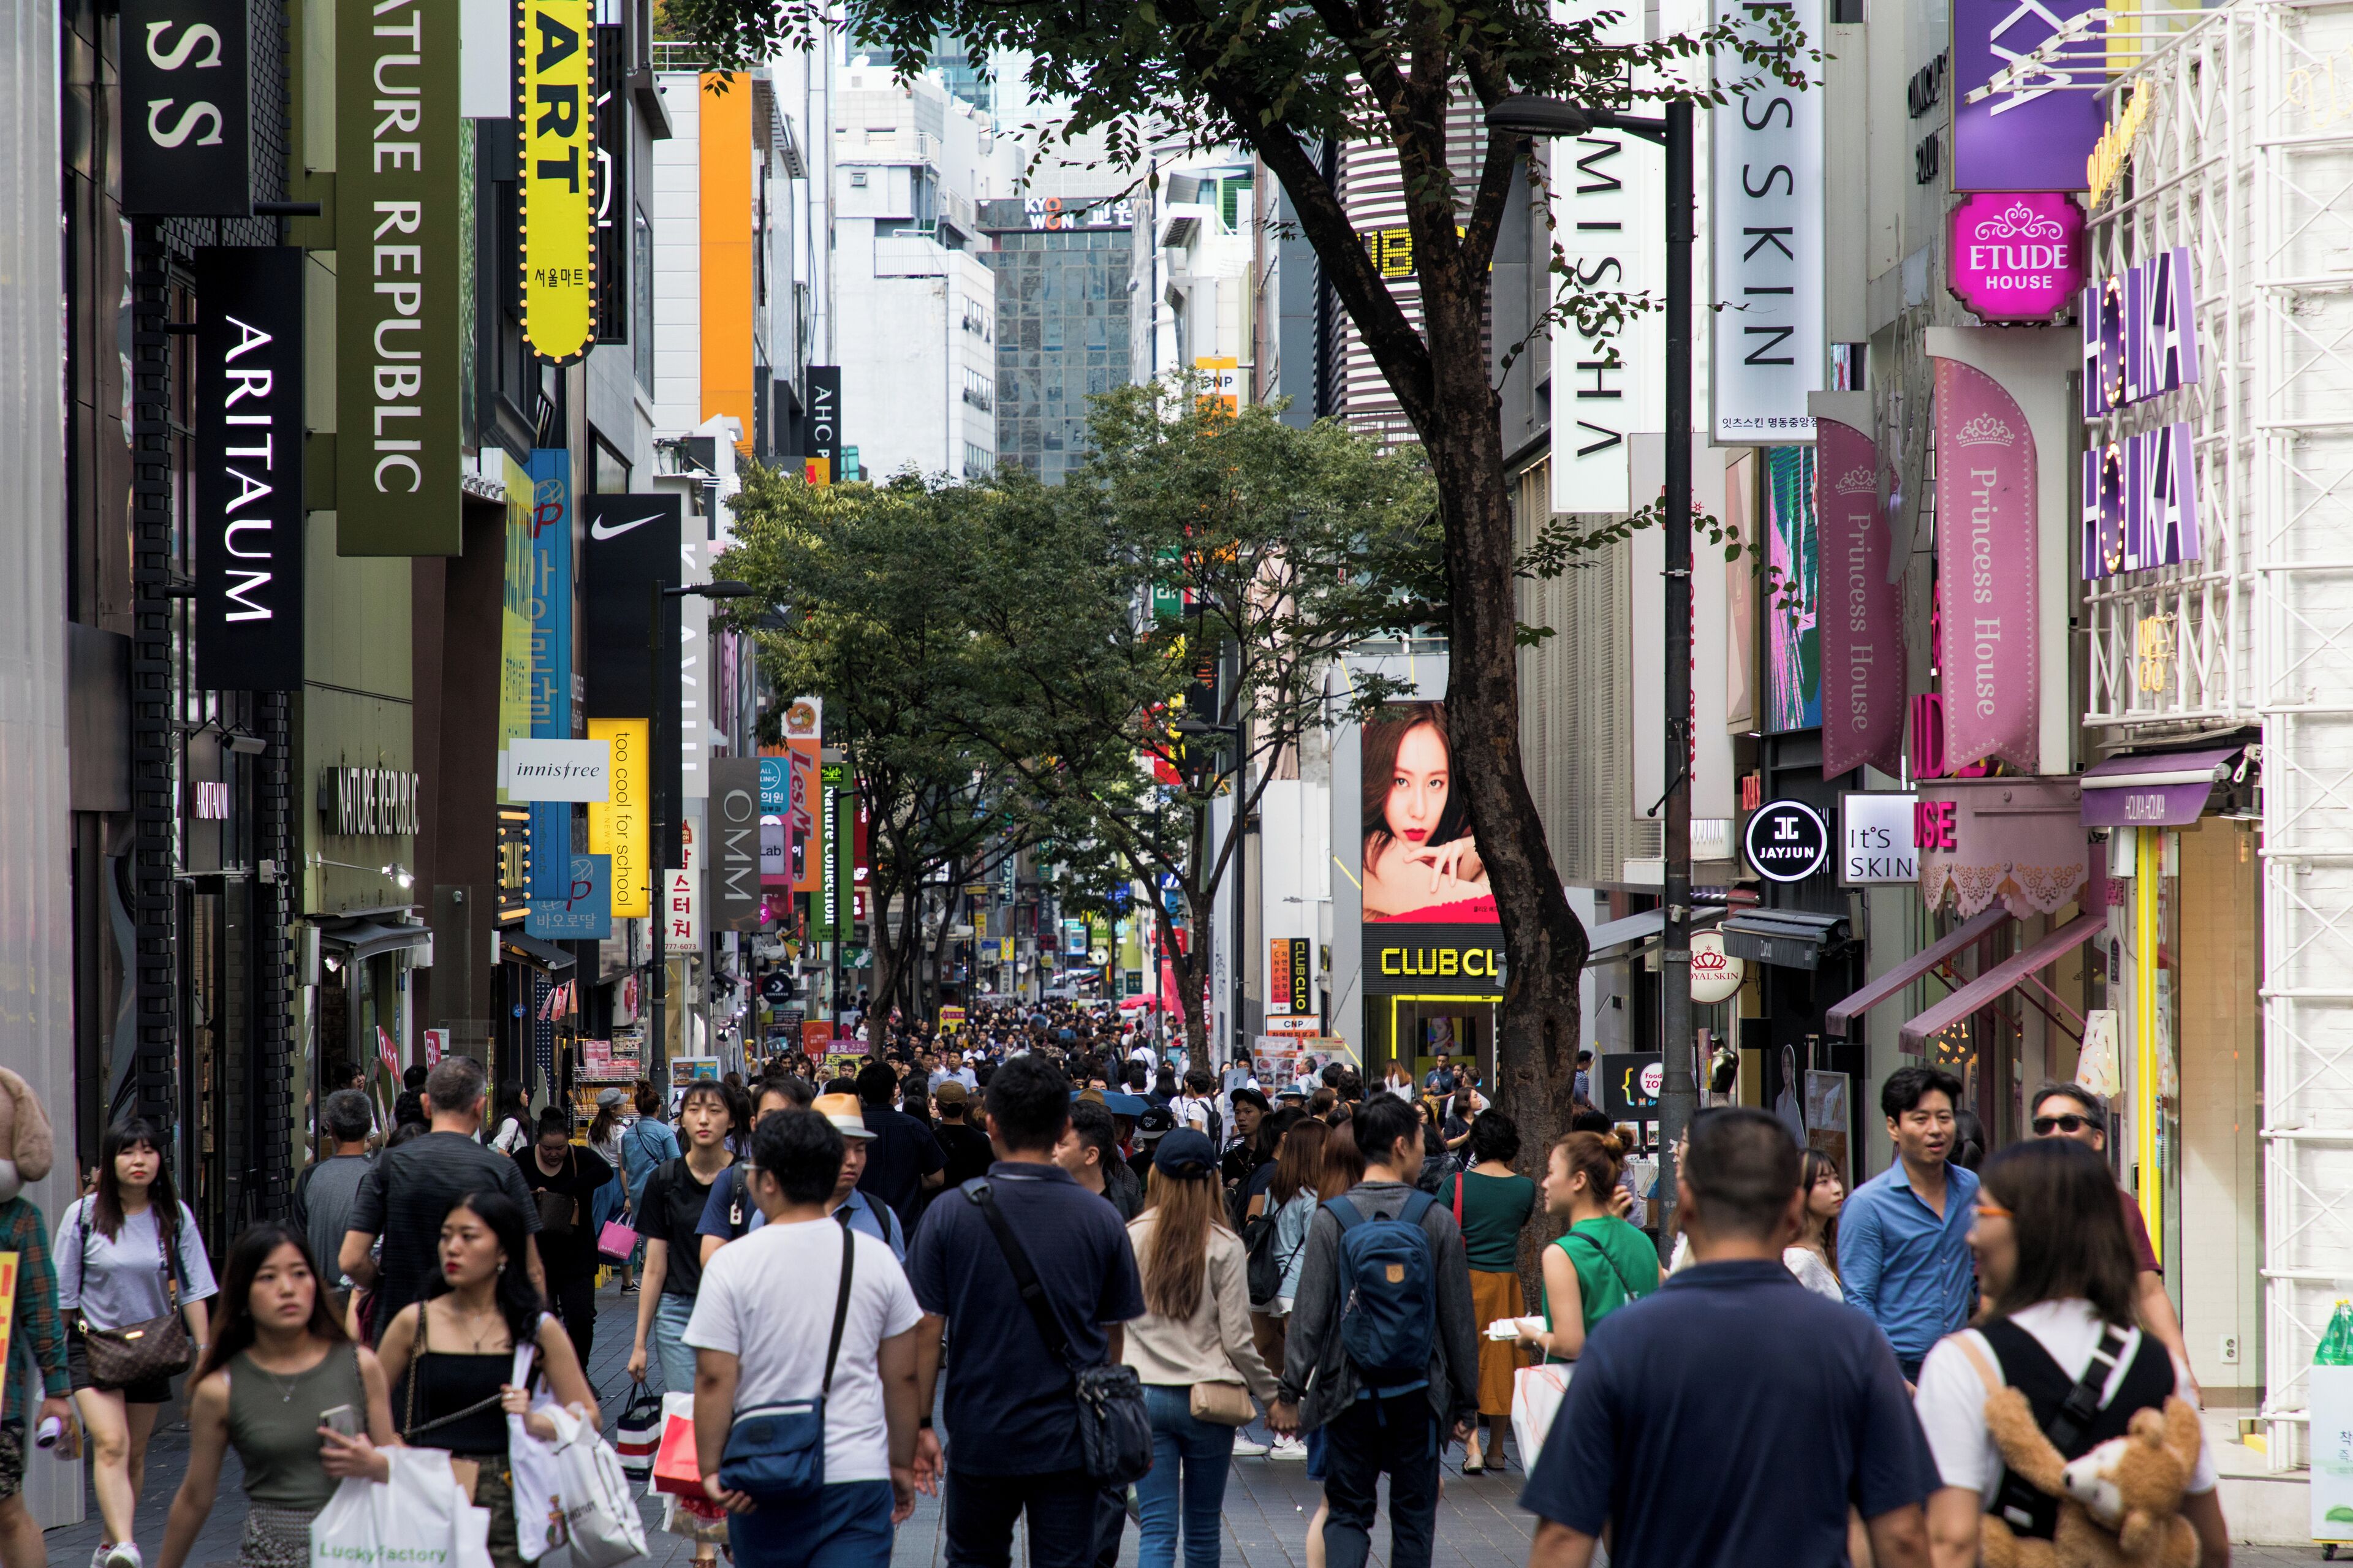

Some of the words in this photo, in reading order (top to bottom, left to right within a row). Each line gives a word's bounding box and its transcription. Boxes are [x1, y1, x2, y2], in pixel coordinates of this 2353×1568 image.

[536, 9, 580, 194] ART
[1025, 197, 1062, 212] KYO
[1029, 213, 1075, 230] WON
[1743, 164, 1795, 365] SKIN
[1969, 244, 2069, 270] ETUDE
[534, 268, 584, 288] 서울마트
[1985, 275, 2053, 289] HOUSE
[373, 202, 422, 493] REPUBLIC
[814, 385, 833, 442] AHC
[1722, 417, 1764, 429] 잇츠스킨
[224, 314, 273, 623] ARITAUM
[1971, 466, 1998, 604] Princess
[1847, 512, 1871, 632] Princess
[1974, 616, 2001, 720] House
[1850, 643, 1874, 734] House
[615, 732, 631, 762] too
[517, 761, 600, 779] innisfree
[195, 782, 228, 819] ARITAUM
[338, 767, 376, 835] NATURE
[377, 769, 420, 835] REPUBLIC
[615, 770, 632, 807] cool
[2124, 794, 2145, 820] HOLIKA
[2145, 794, 2165, 820] HOLIKA
[616, 814, 632, 839] for
[724, 789, 752, 901] OMM
[1759, 847, 1815, 859] JAYJUN
[616, 844, 633, 906] school
[1850, 857, 1913, 878] SKIN
[536, 912, 597, 930] 바오로딸
[601, 1244, 619, 1255] BANILA
